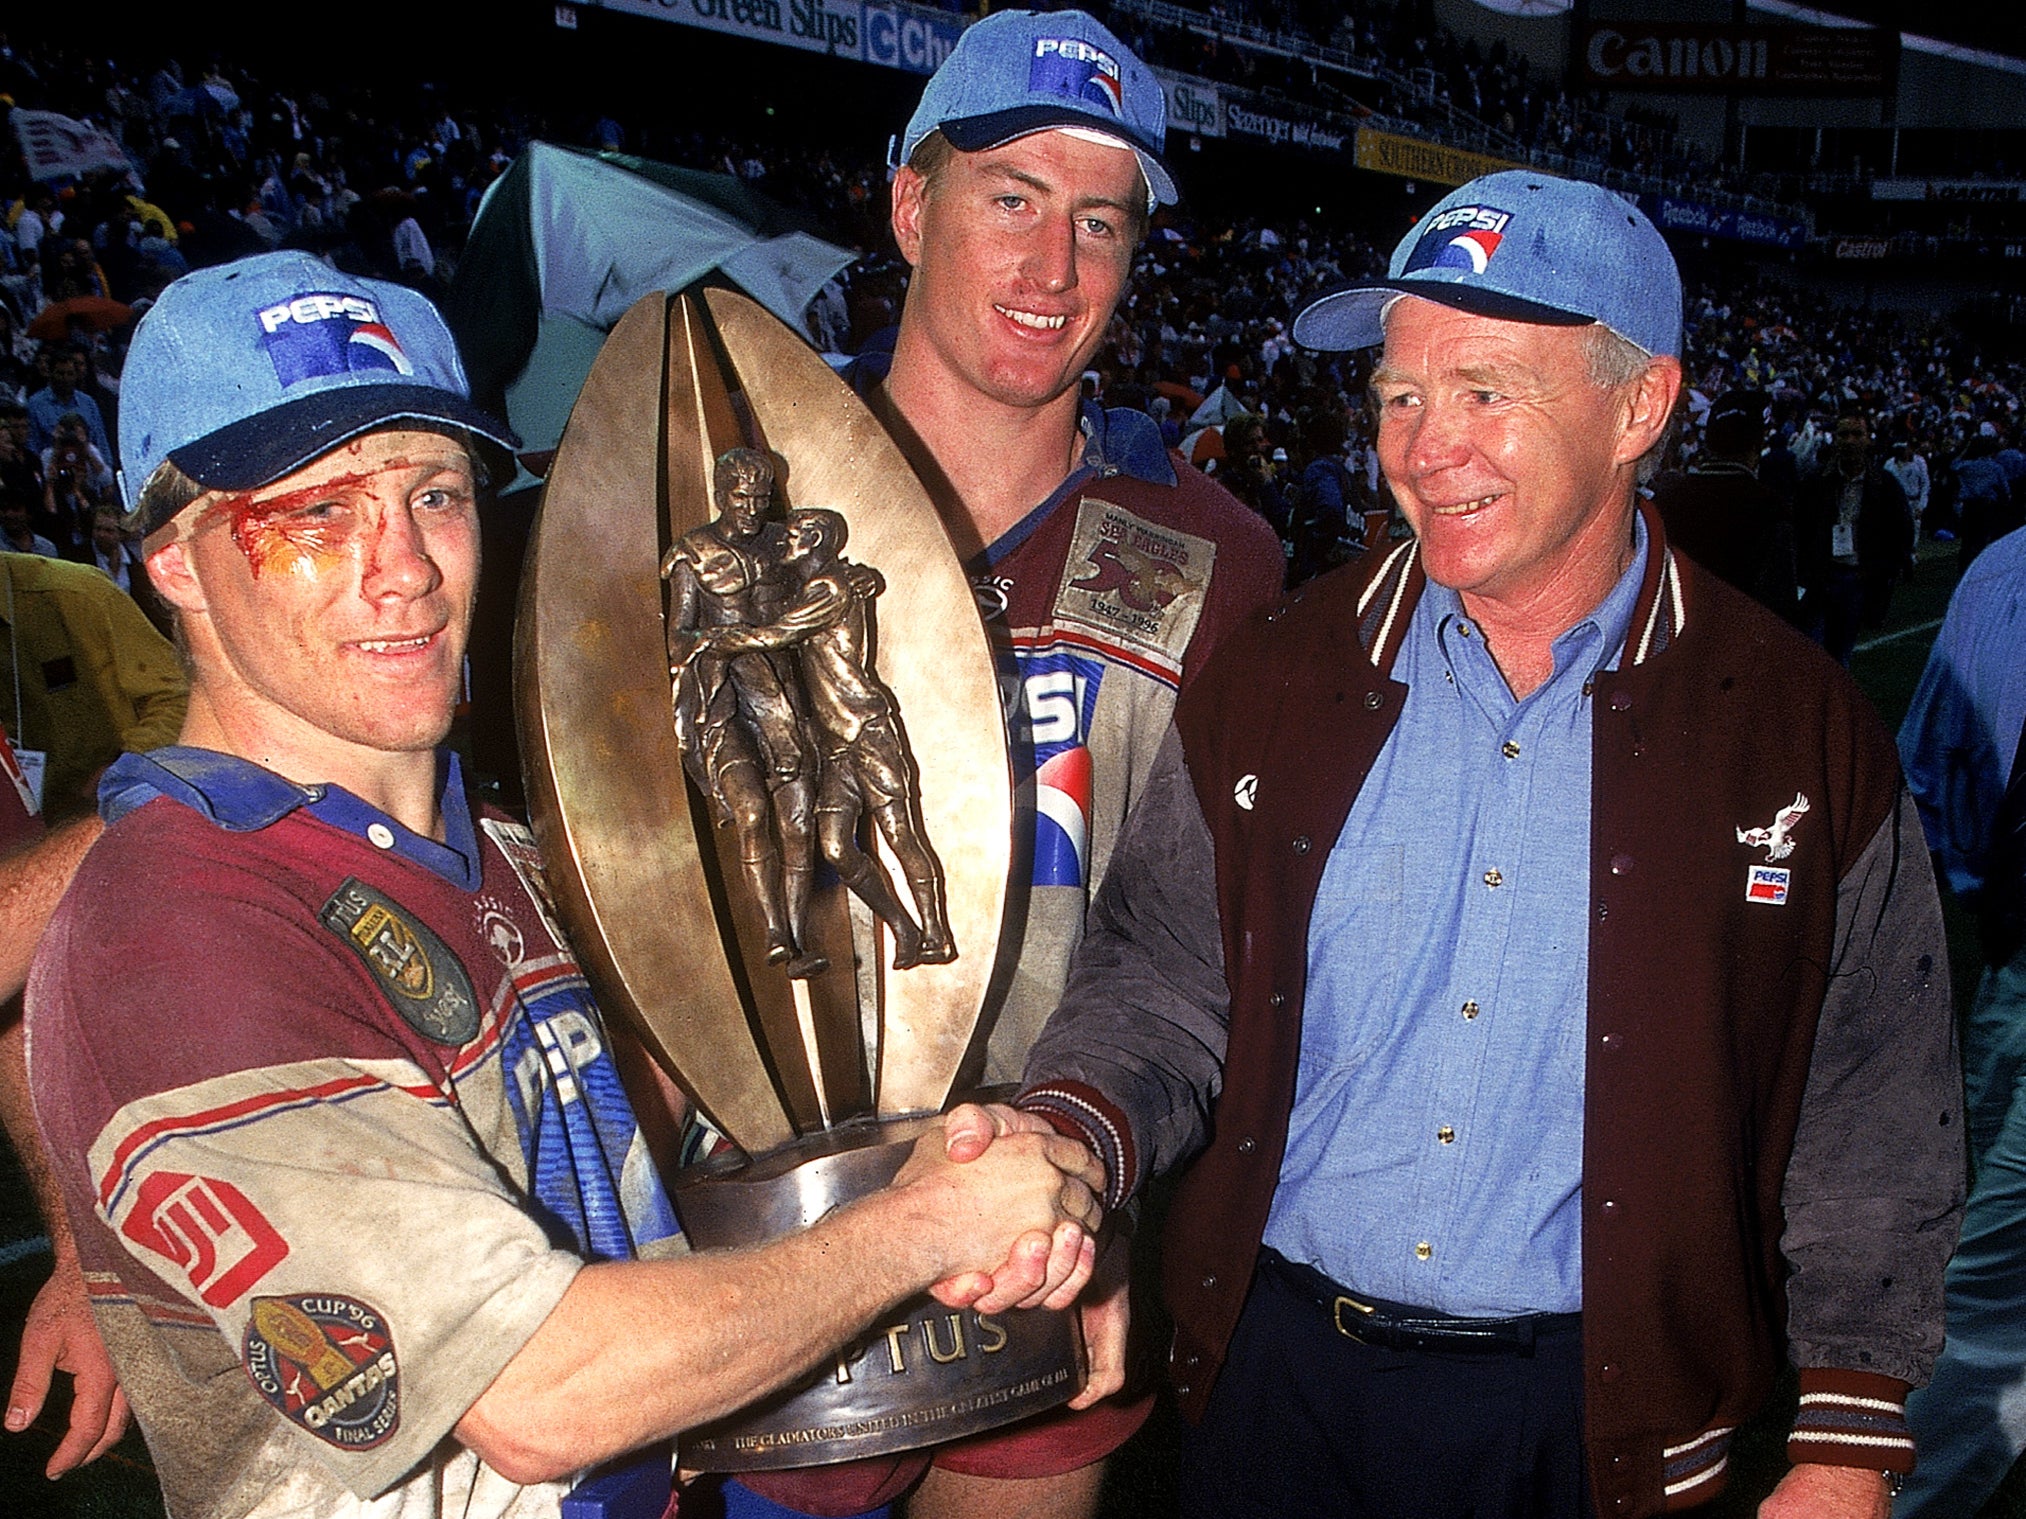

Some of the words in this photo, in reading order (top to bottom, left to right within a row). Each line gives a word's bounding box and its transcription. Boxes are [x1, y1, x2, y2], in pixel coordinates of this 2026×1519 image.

[788, 0, 858, 57] Slips
[1036, 39, 1119, 80] PEPSI
[1586, 29, 1769, 79] Canon
[1174, 85, 1216, 133] Slips
[1423, 207, 1510, 236] PEPSI
[1836, 240, 1888, 259] Castrol
[259, 294, 380, 333] PEPSI
[1134, 535, 1189, 565] EAGLES
[1090, 598, 1120, 617] 1947
[1131, 613, 1160, 633] 1996
[1755, 870, 1788, 883] PEPSI
[301, 1298, 345, 1316] CUP
[347, 1304, 376, 1329] '96
[250, 1339, 279, 1394] OPTUS
[304, 1352, 396, 1429] QANTAS
[335, 1426, 376, 1443] FINAL
[734, 1436, 757, 1450] THE
[758, 1427, 844, 1448] GLADIATORS
[846, 1415, 900, 1437] UNITED
[901, 1410, 918, 1426] IN
[919, 1406, 947, 1422] THE
